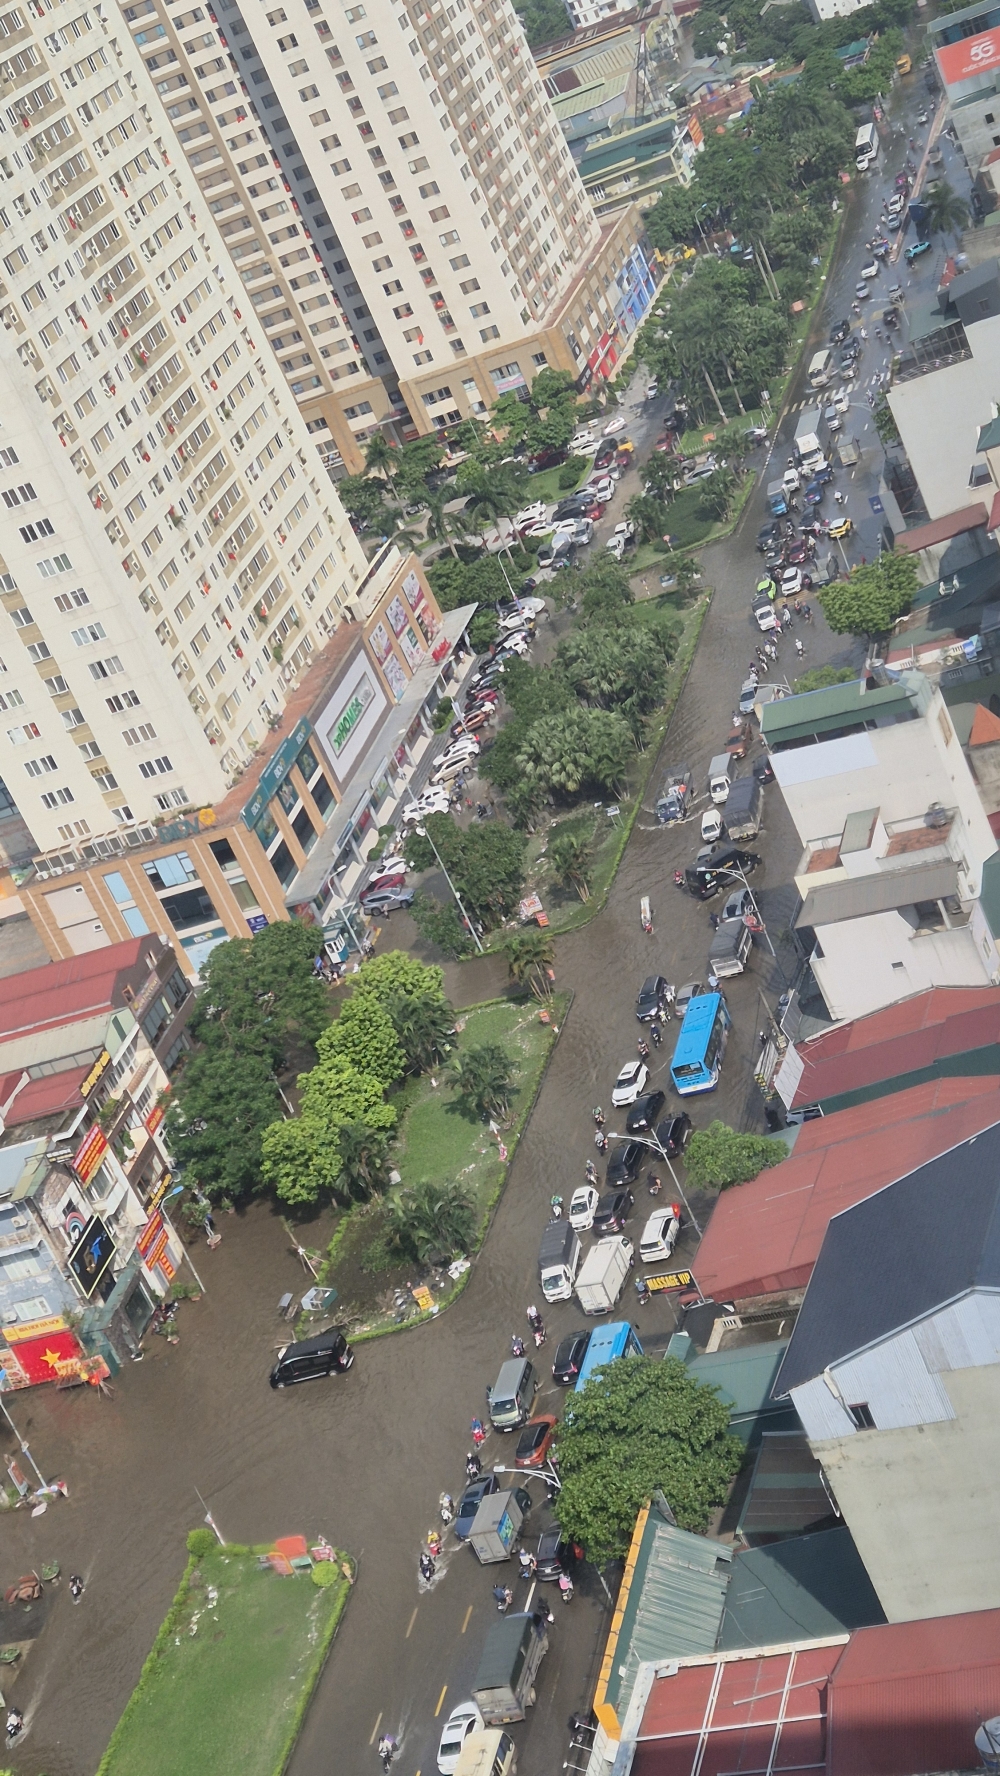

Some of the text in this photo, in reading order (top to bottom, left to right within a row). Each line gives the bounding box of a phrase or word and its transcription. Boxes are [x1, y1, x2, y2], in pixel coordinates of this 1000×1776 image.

[970, 40, 996, 62] 5G
[157, 816, 200, 844] BIDV
[646, 1272, 690, 1291] MASSAGE VIP
